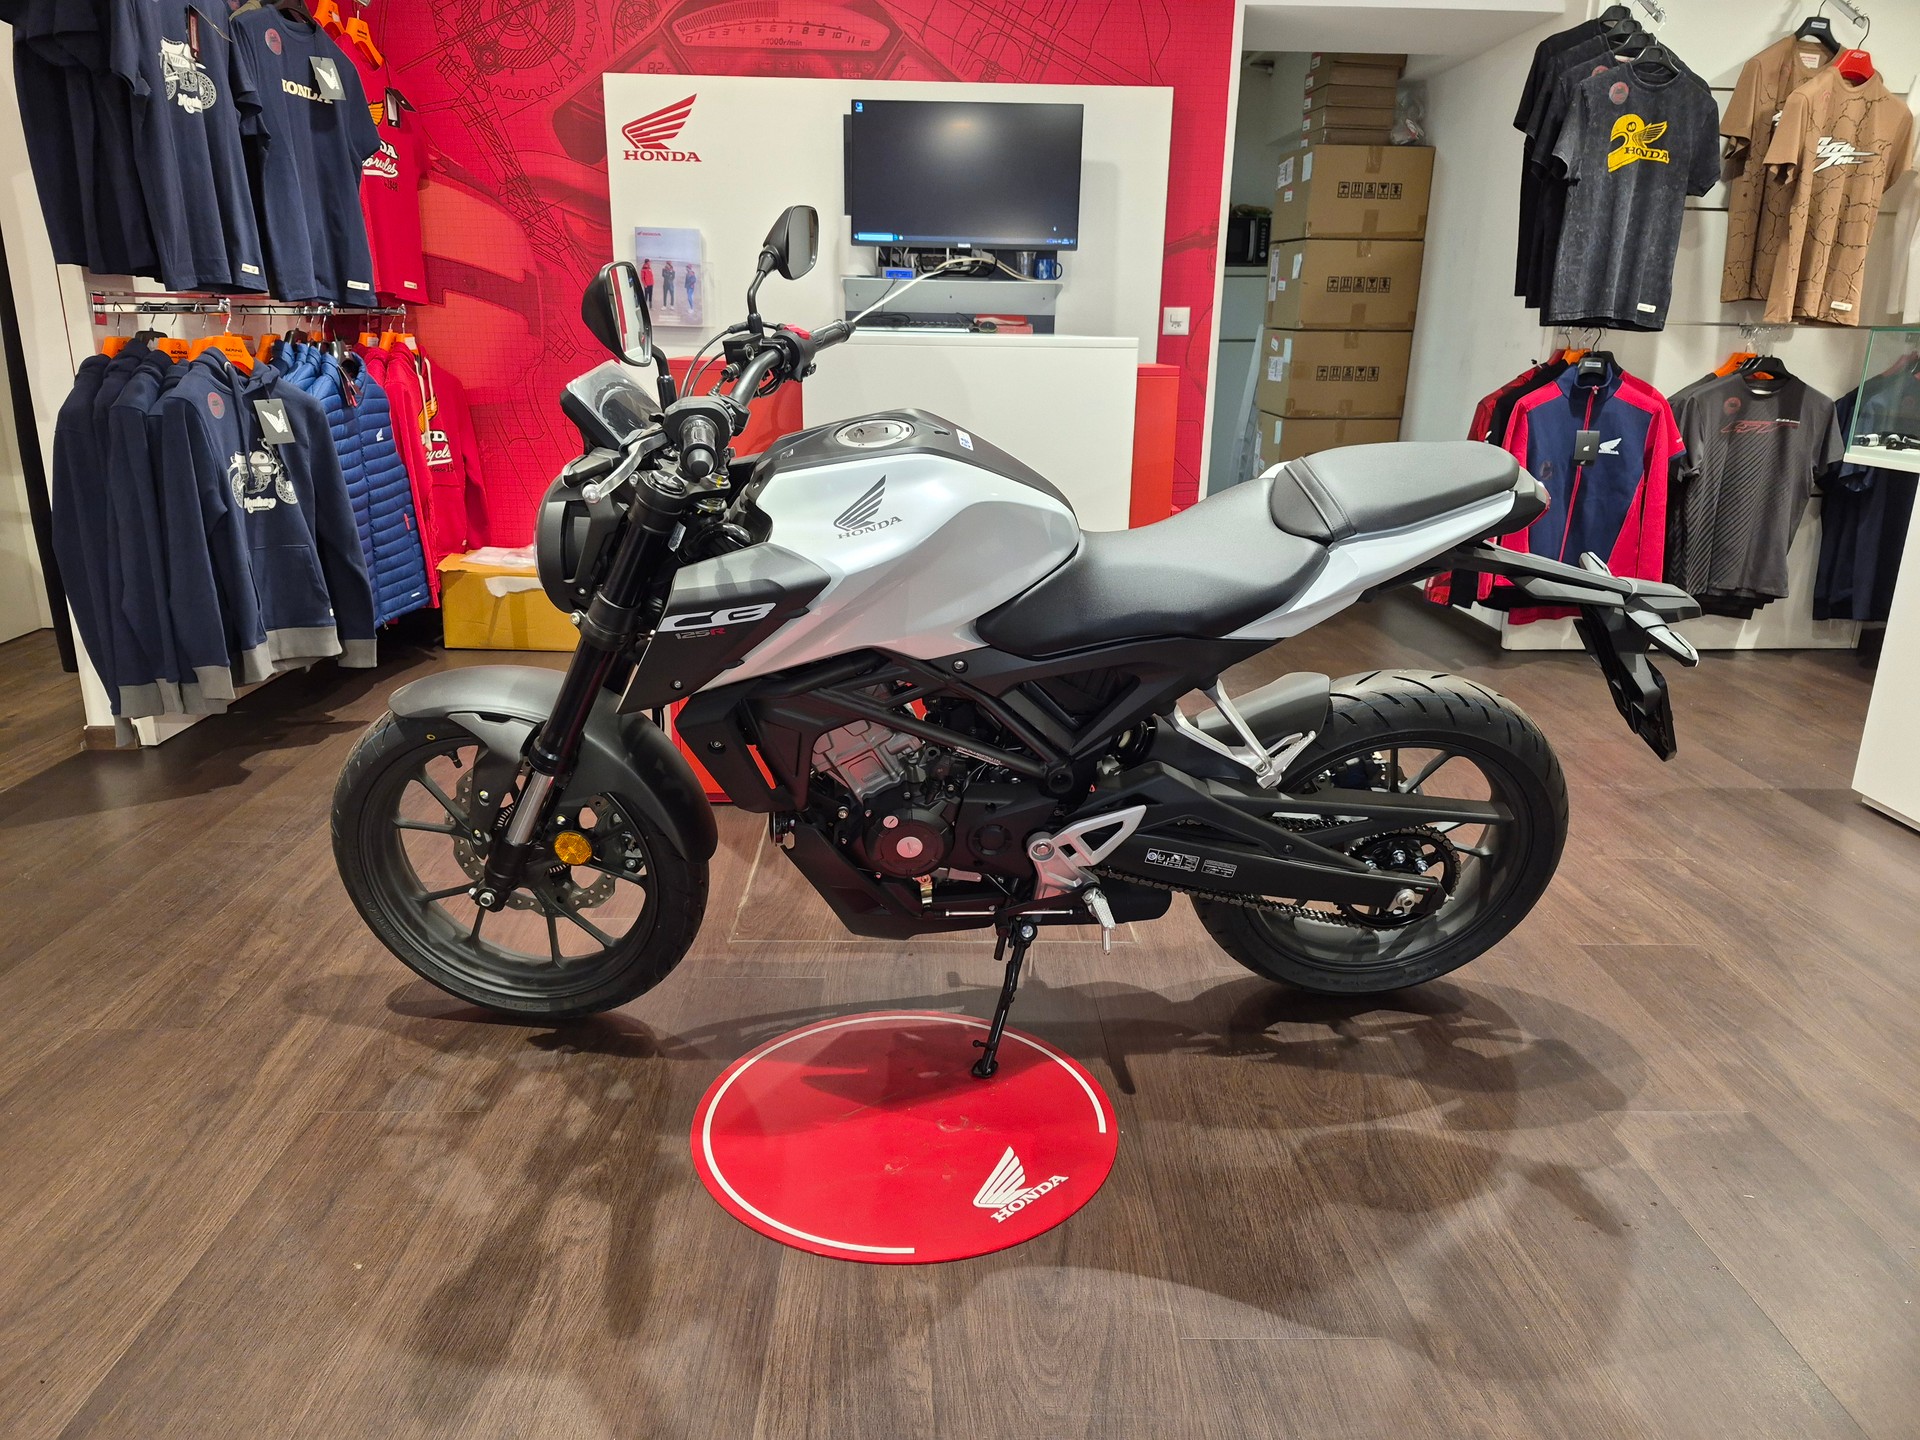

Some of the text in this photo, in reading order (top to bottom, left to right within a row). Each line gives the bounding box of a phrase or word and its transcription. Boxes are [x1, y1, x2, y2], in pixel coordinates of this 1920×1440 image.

[708, 31, 716, 39] 2
[722, 28, 730, 36] 3
[738, 26, 746, 35] 4
[754, 25, 762, 33] 5
[769, 25, 777, 33] 6
[786, 26, 794, 34] 7
[802, 26, 810, 35] 8
[817, 28, 825, 37] 9
[832, 31, 842, 39] 10
[847, 35, 855, 44] 11
[861, 39, 871, 47] 12
[622, 149, 703, 163] HONDA
[1623, 147, 1669, 162] HONDA
[837, 516, 903, 540] HONDA
[657, 602, 777, 632] CB
[675, 627, 726, 640] 125R
[990, 1175, 1070, 1224] HONDA
